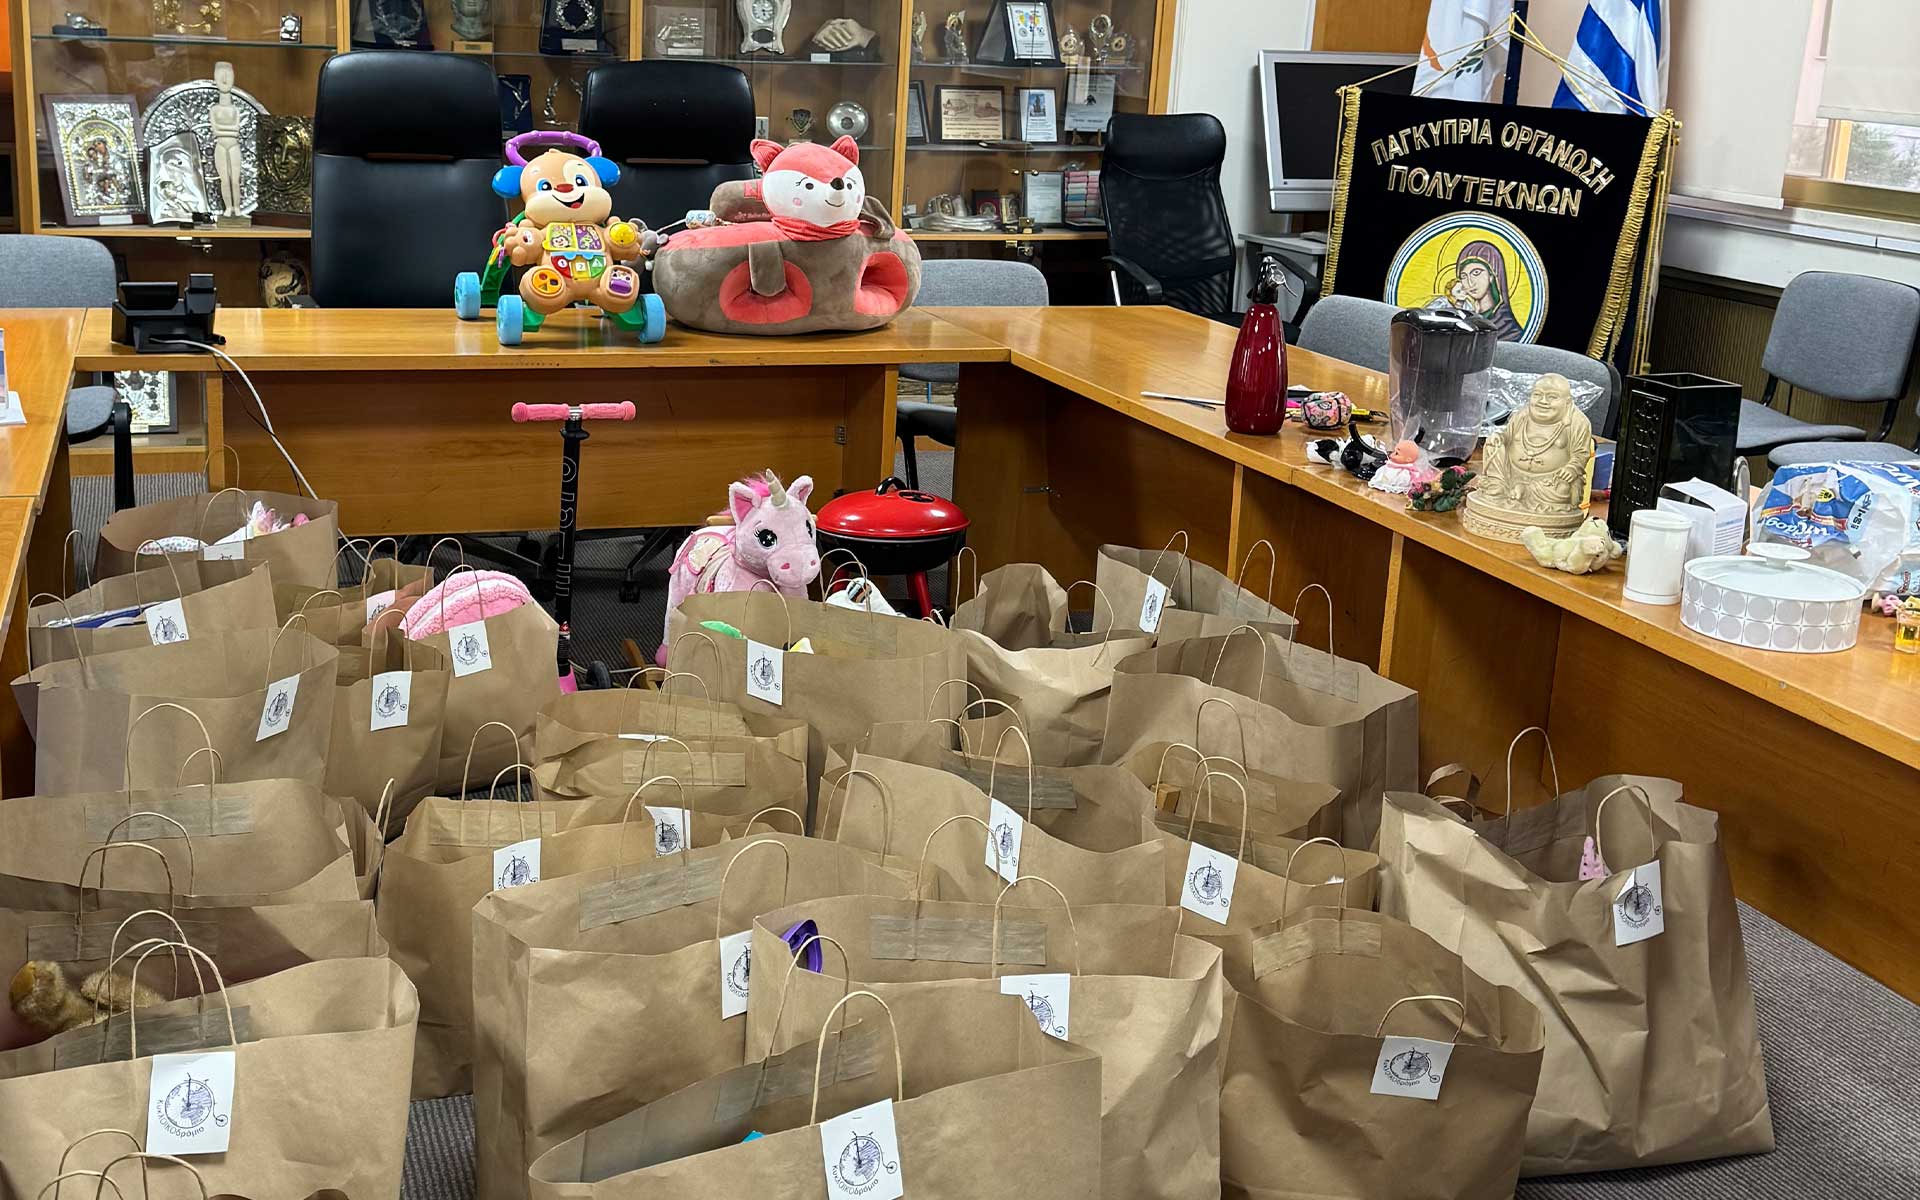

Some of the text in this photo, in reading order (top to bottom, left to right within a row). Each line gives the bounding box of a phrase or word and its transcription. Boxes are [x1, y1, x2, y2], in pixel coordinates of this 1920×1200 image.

[1371, 118, 1615, 195] ΠΑΓΚΥΠΡΙΑ ΟΡΓΑΝΩΣΗ
[1387, 165, 1583, 217] ΠΟΛΥΤΕΚΝΩΝ
